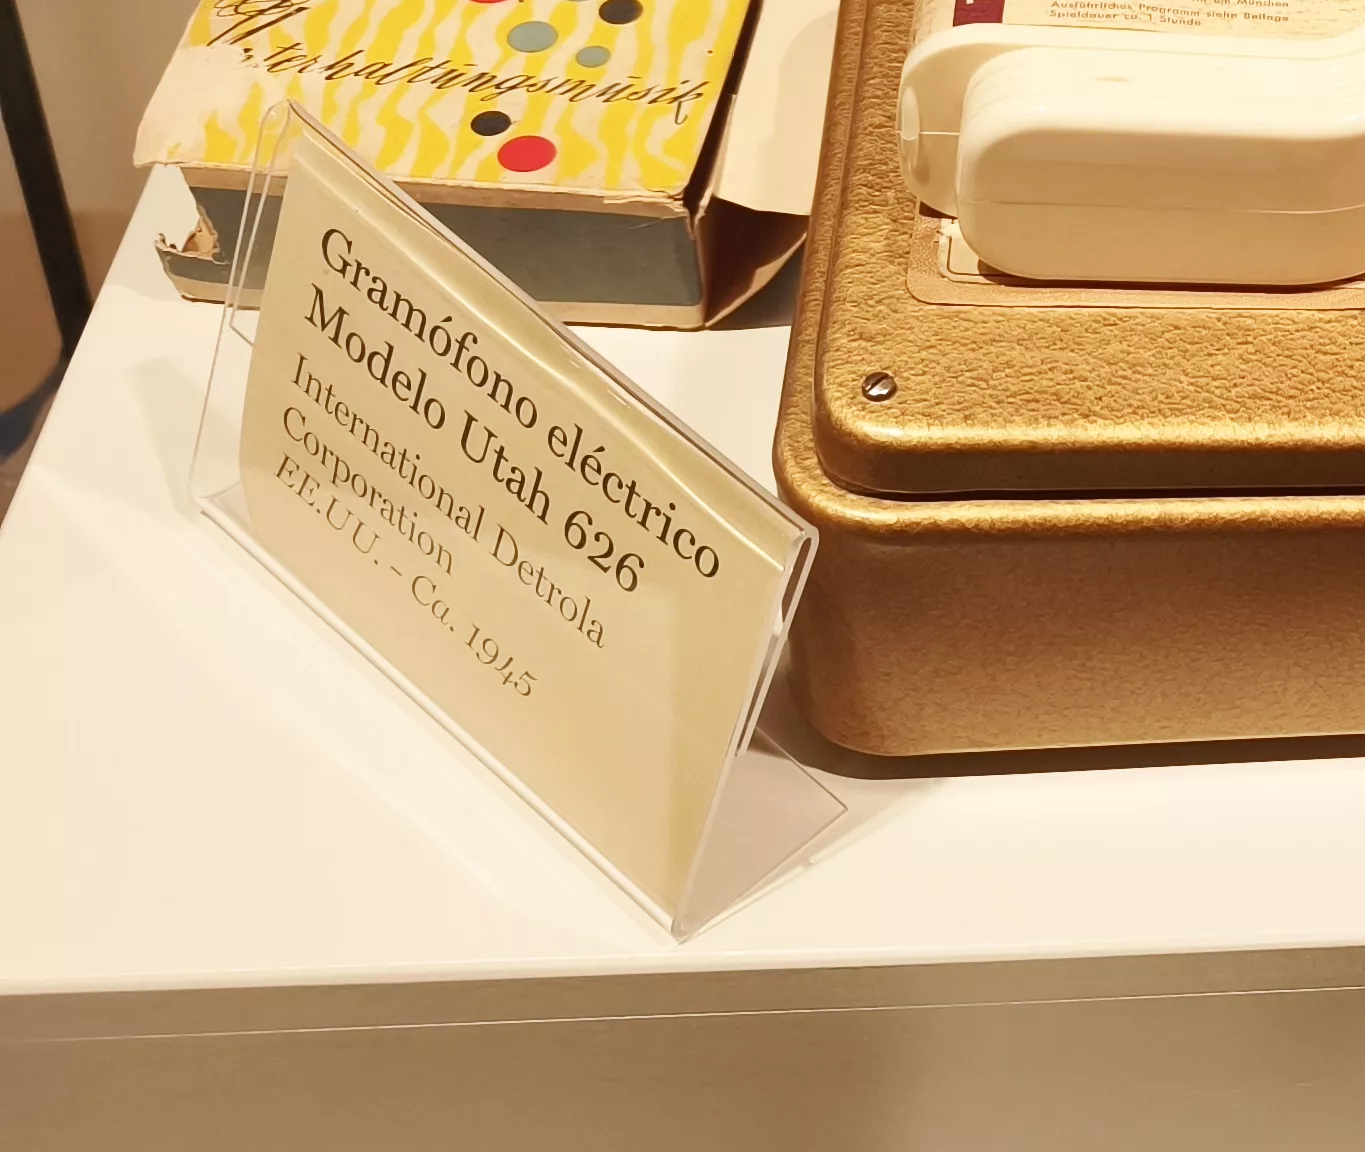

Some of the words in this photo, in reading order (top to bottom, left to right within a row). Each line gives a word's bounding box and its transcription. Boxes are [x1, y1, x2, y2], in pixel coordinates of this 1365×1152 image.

[1138, 3, 1201, 17] Programm
[282, 406, 455, 577] Corporation
[290, 352, 486, 545] International
[494, 525, 606, 649] Detrola
[304, 283, 446, 430] Modelo
[460, 411, 551, 523] Utah
[563, 510, 646, 593] 626
[320, 228, 539, 429] Gramófono
[546, 422, 721, 579] eléctrico
[272, 453, 381, 567] EE.UU.
[411, 575, 456, 632] Ca.
[464, 624, 540, 698] 1945
